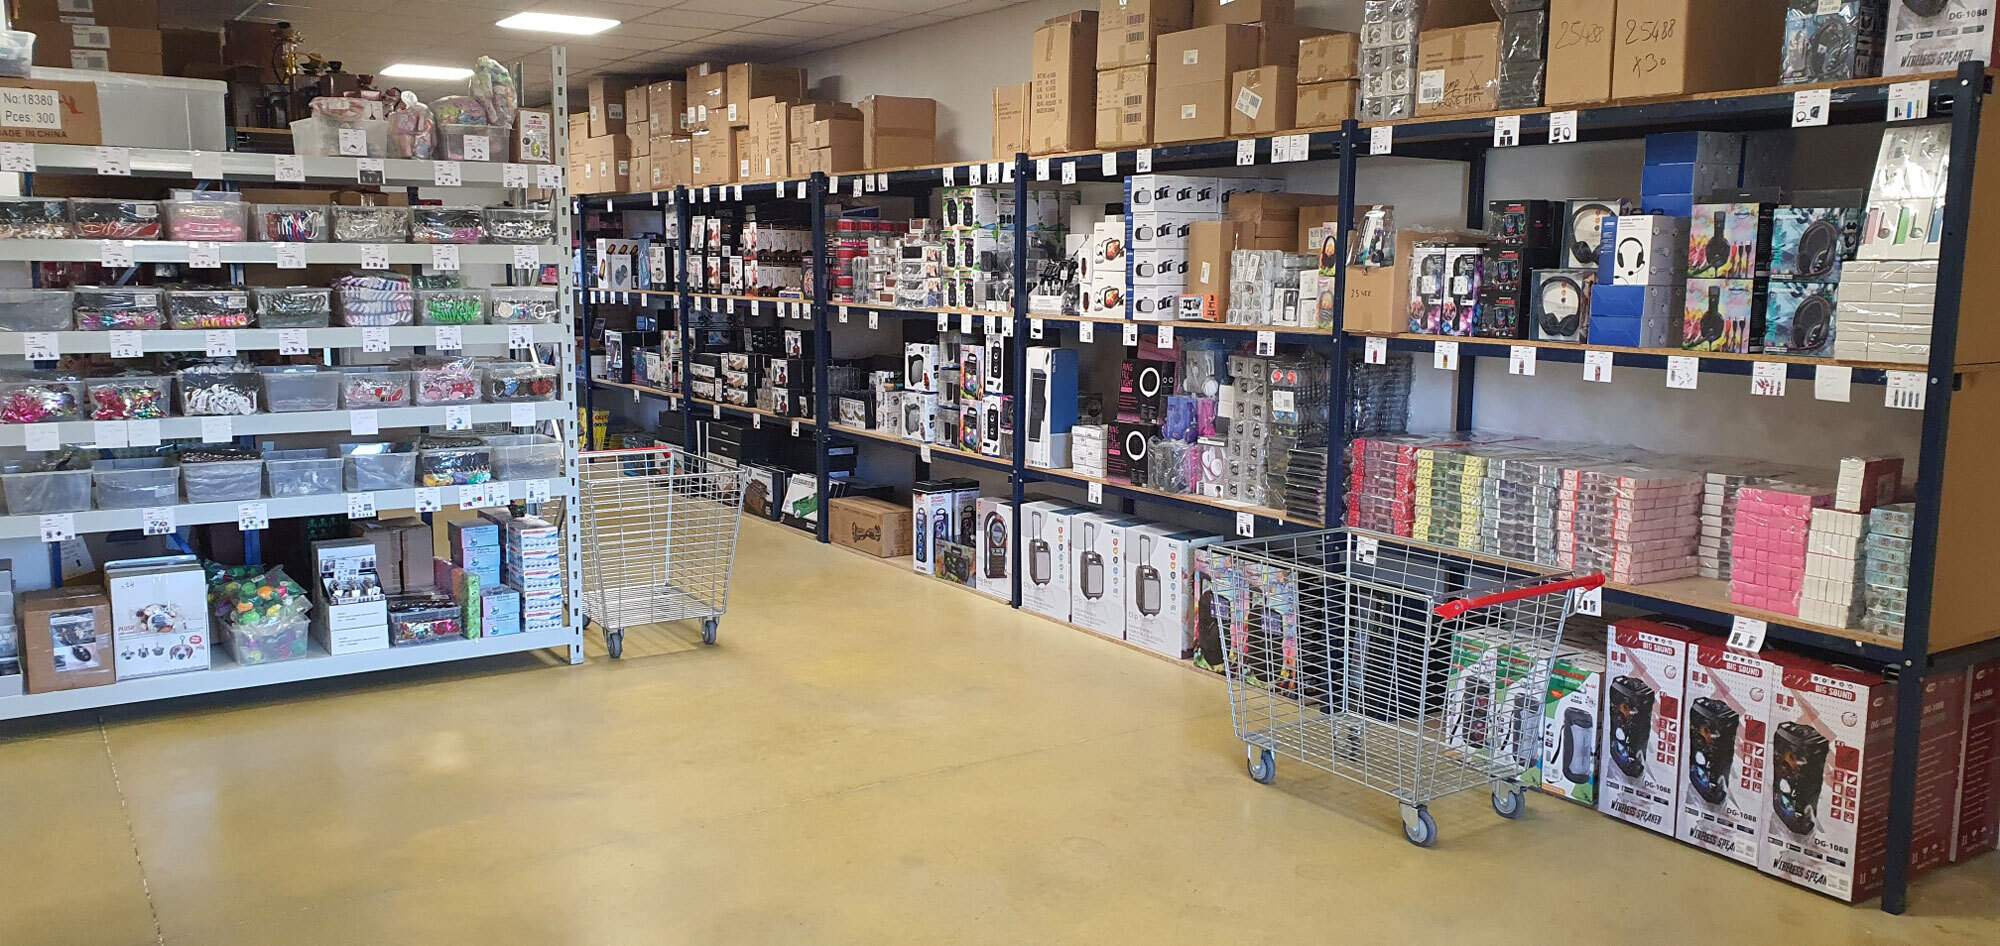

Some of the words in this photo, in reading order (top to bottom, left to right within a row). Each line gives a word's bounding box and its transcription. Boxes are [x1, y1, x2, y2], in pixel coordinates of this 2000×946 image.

[1949, 9, 1988, 20] DG-1088
[1624, 18, 1677, 45] 25488
[3, 92, 53, 106] No:18380
[5, 110, 34, 123] Pces:
[36, 112, 55, 124] 300
[0, 129, 21, 138] ADE
[25, 130, 36, 138] IN
[37, 130, 68, 139] CHINA
[1642, 641, 1653, 650] BIG
[1653, 643, 1674, 656] SOUND
[1726, 662, 1737, 671] BIG
[1738, 664, 1760, 677] SOUND
[1815, 685, 1827, 694] BIG
[1828, 687, 1853, 700] SOUND
[1644, 780, 1671, 794] DG-1088
[1611, 798, 1637, 816] WIRELESS
[1636, 809, 1662, 825] SPEAKER
[1727, 807, 1757, 822] DG-1088
[1718, 838, 1735, 852] SPEA
[1814, 838, 1849, 854] DG-1088
[1773, 855, 1805, 877] WIRELESS
